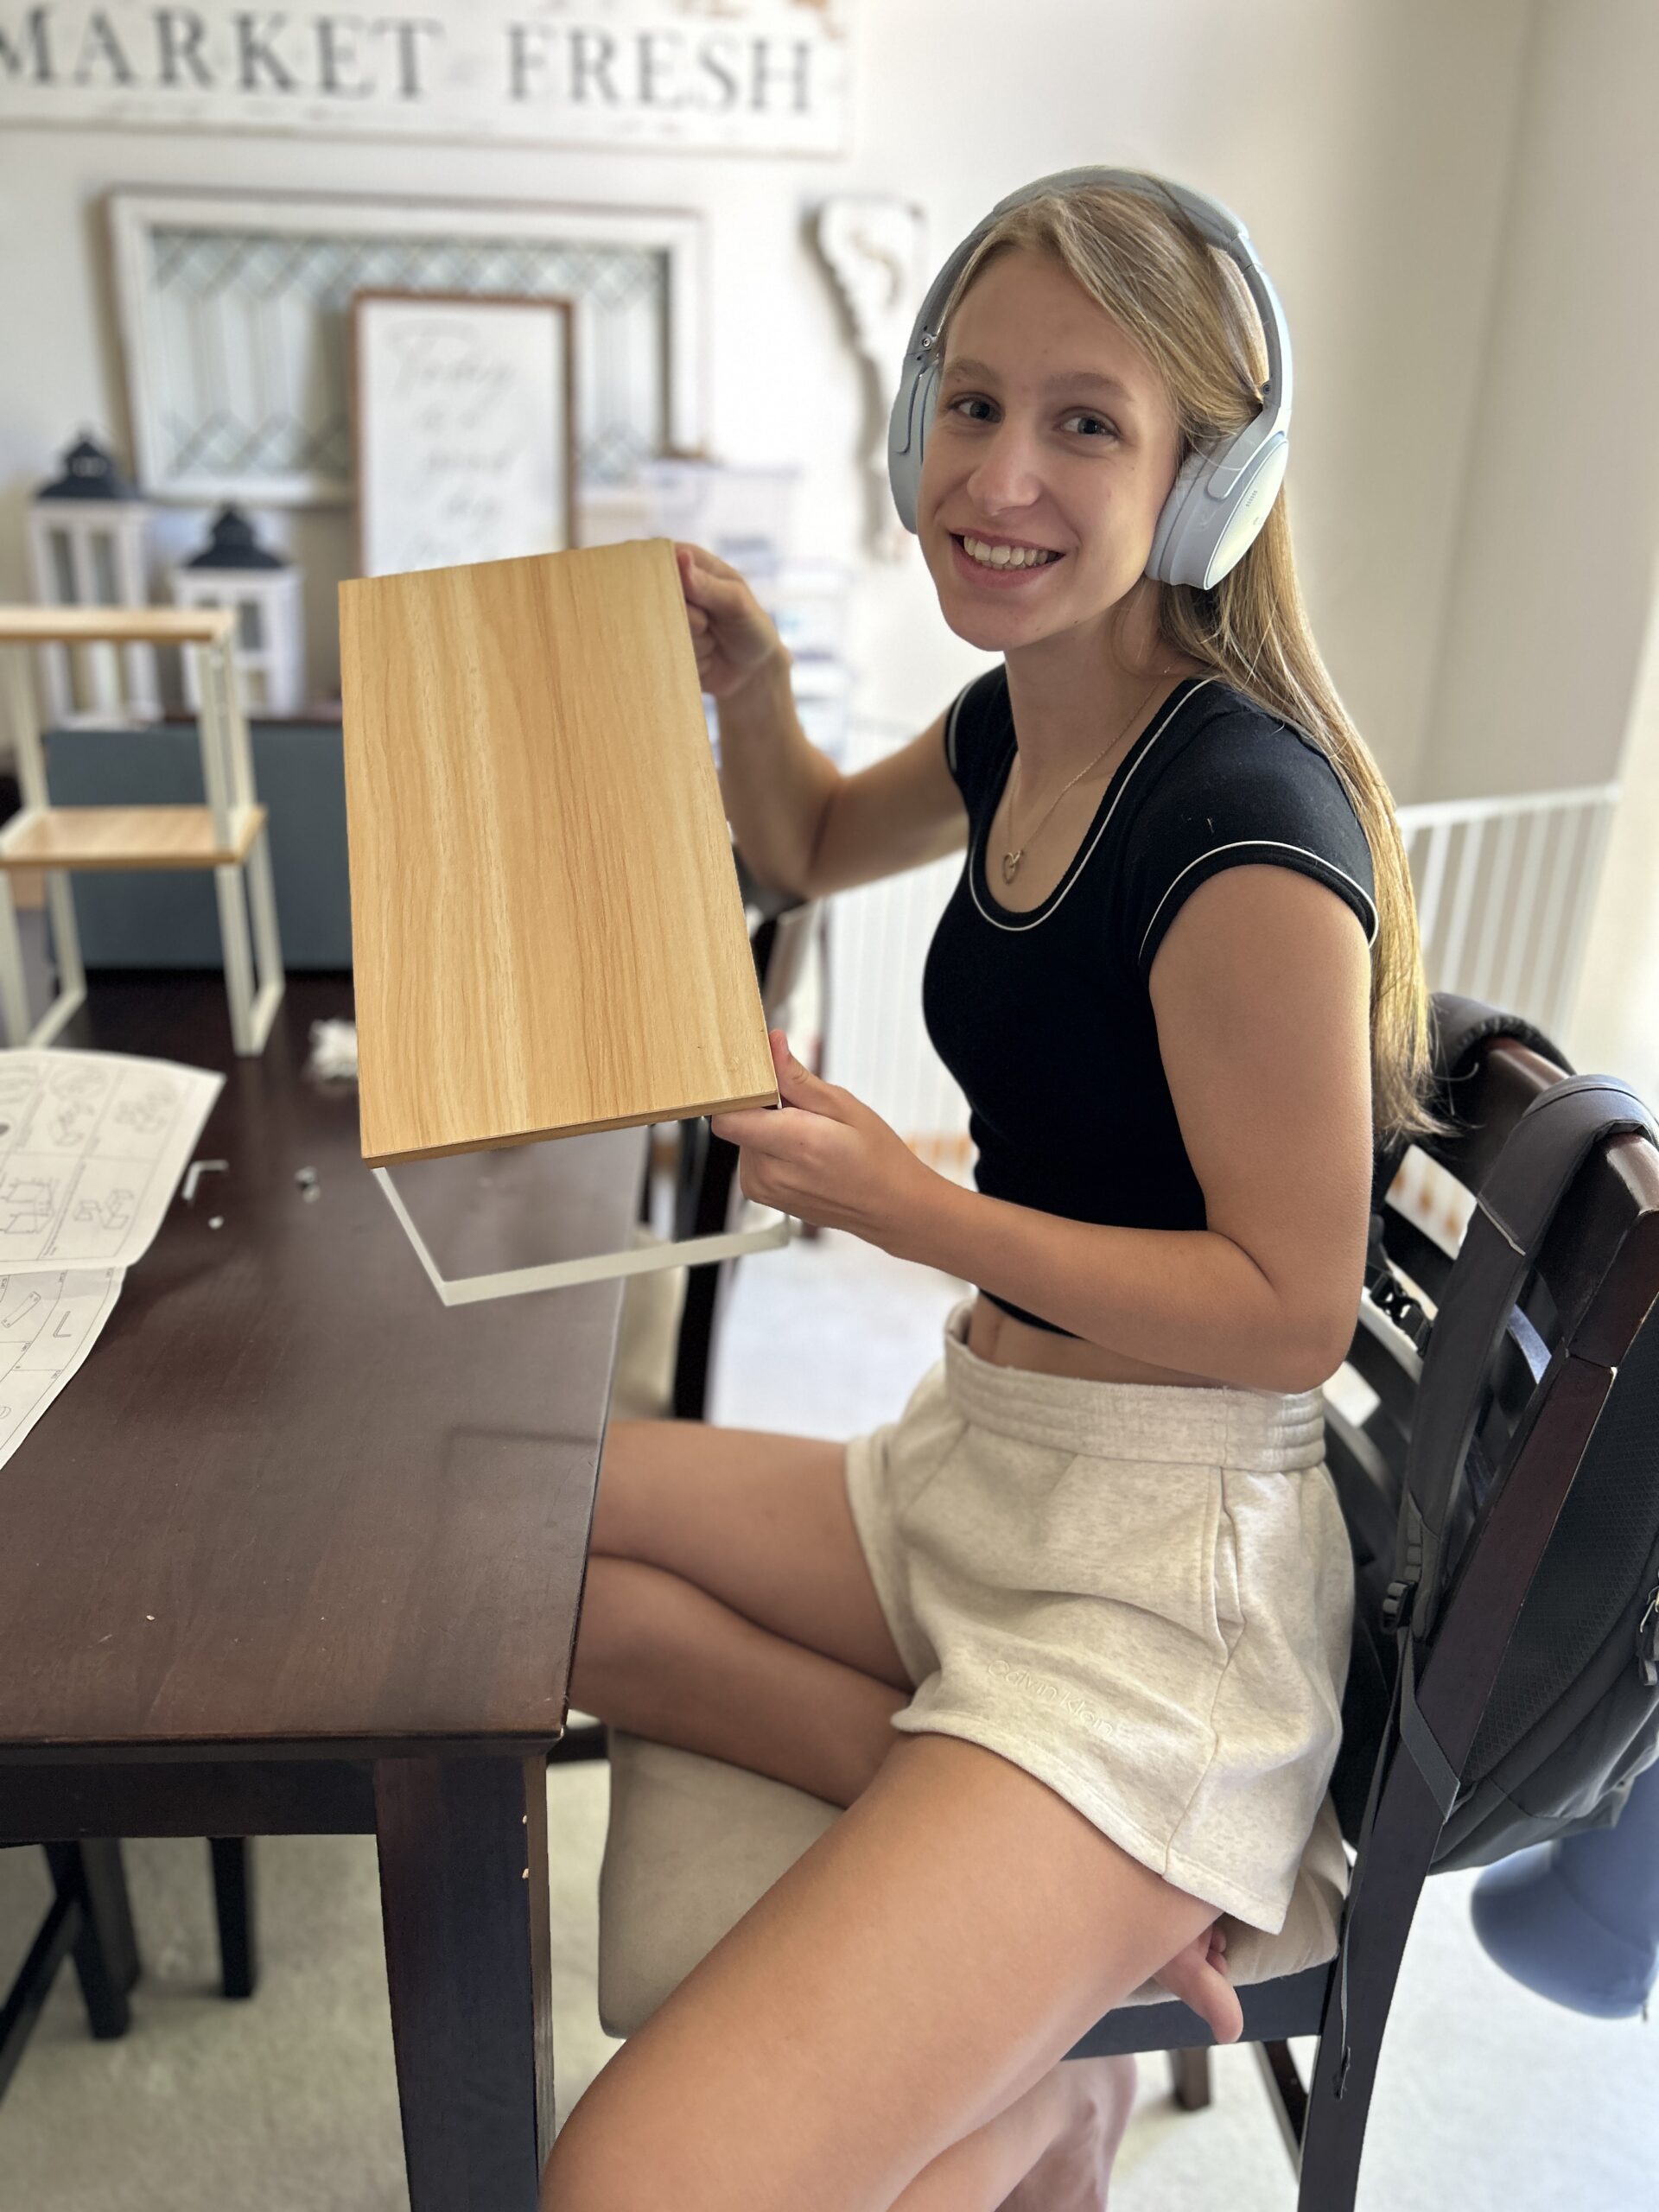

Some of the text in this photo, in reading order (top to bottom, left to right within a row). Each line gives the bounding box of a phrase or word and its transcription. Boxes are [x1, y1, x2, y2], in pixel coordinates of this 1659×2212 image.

[0, 5, 811, 113] MARKET FRESH
[988, 1660, 1113, 1737] Calvin Klein
